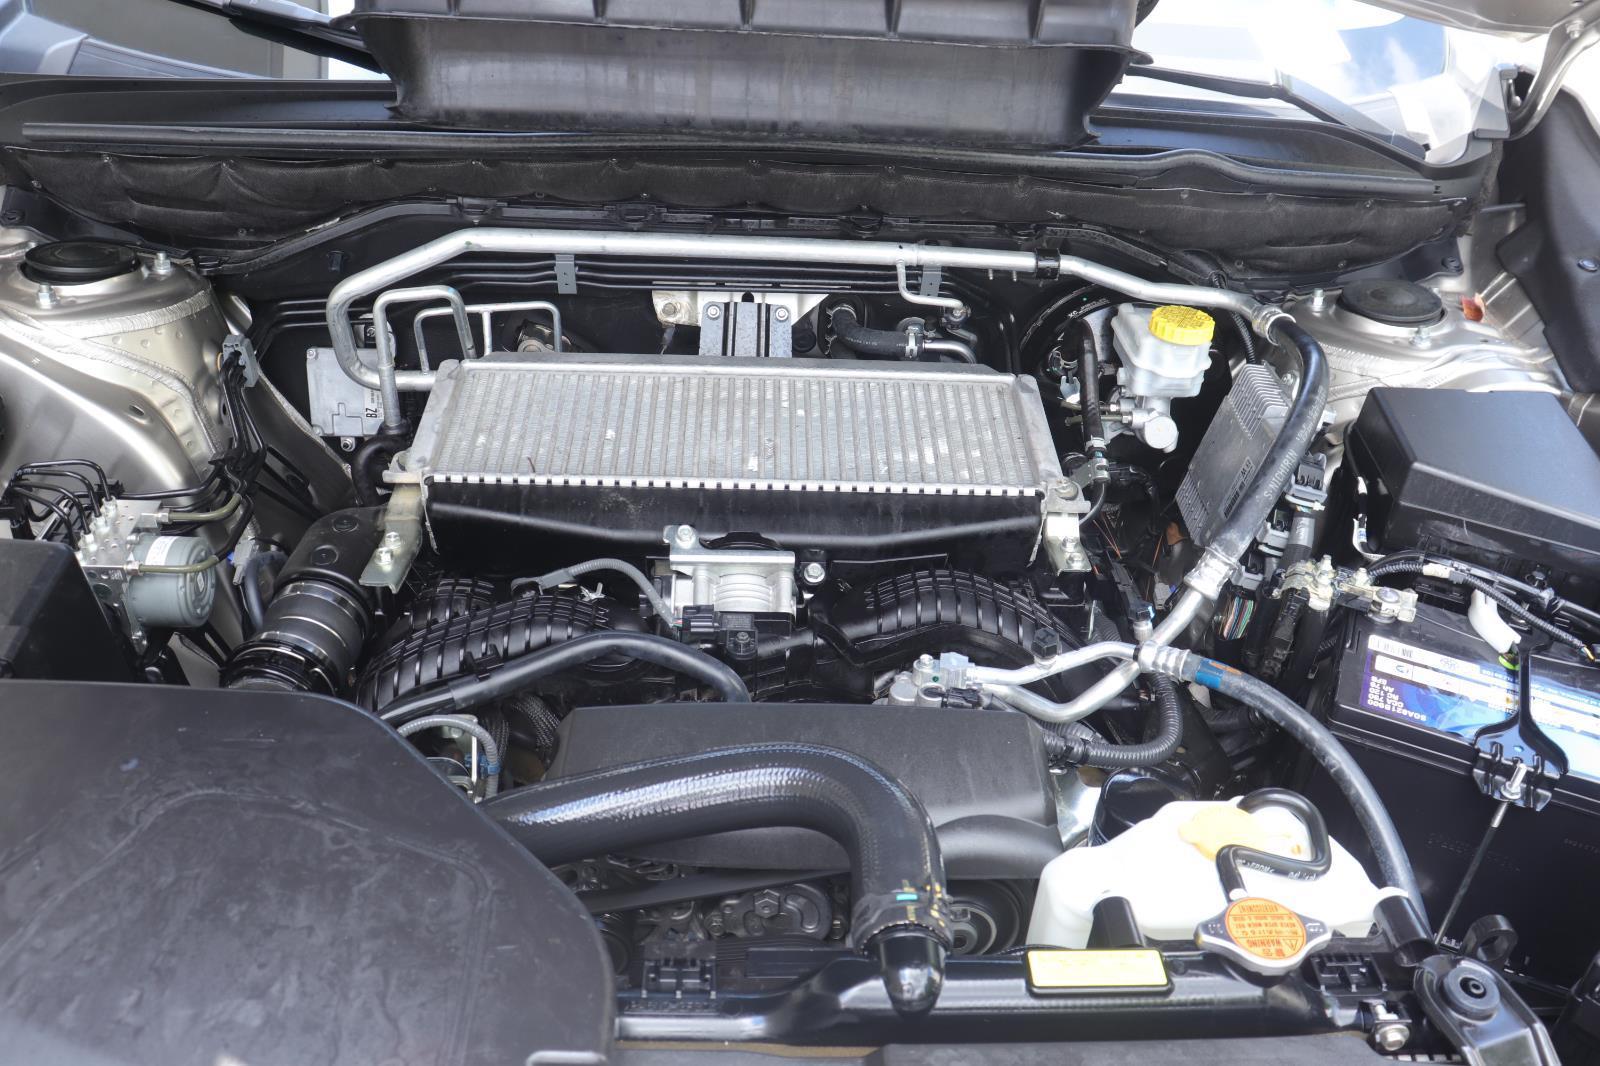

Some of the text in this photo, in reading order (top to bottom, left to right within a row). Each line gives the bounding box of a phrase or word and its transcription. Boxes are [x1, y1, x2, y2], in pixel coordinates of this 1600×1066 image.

[366, 408, 377, 418] BZ
[1386, 698, 1404, 708] CCA
[1247, 939, 1281, 948] WARNING
